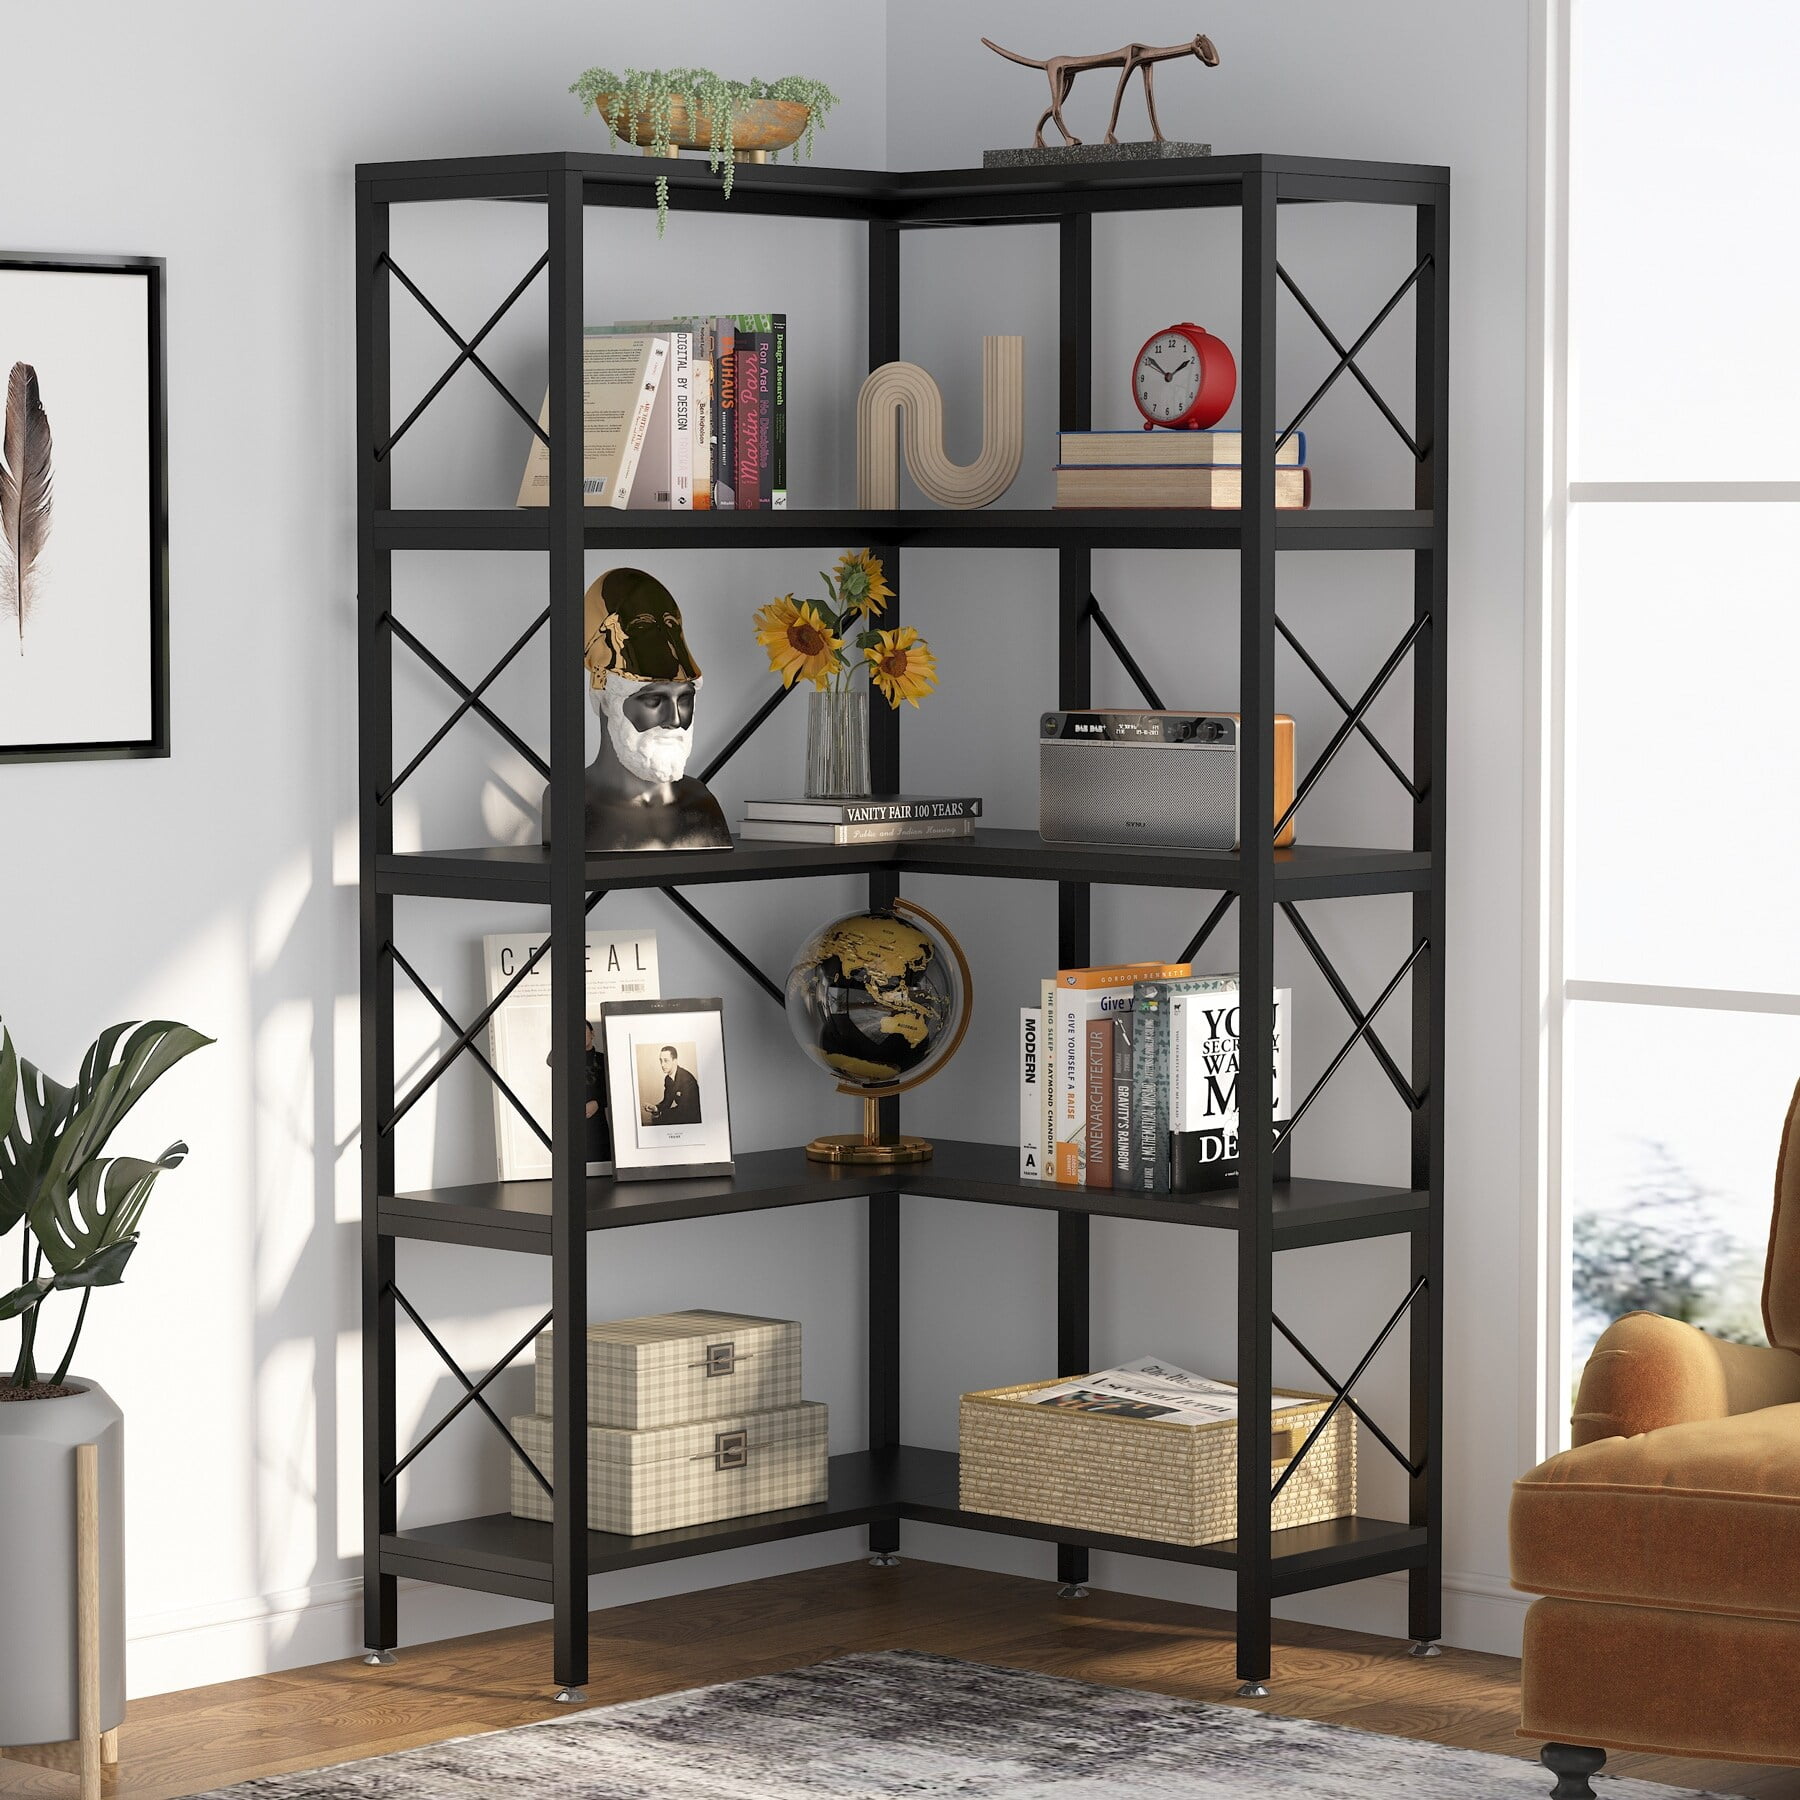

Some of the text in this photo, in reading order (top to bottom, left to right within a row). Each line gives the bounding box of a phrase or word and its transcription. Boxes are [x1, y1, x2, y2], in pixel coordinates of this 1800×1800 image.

[760, 342, 768, 364] Ron
[775, 334, 784, 364] Design
[1155, 345, 1162, 354] 11
[1168, 339, 1177, 349] 12
[1183, 344, 1187, 353] 1
[1190, 356, 1196, 365] 2
[677, 333, 687, 431] DIGITAL BY DESIGN
[721, 337, 735, 409] BAUHAUS
[760, 367, 768, 392] Arad
[1140, 374, 1145, 383] 9
[1194, 373, 1199, 382] 3
[776, 365, 784, 406] Research
[760, 399, 769, 416] No
[1152, 403, 1157, 412] 7
[1165, 407, 1170, 416] 6
[1178, 402, 1183, 411] 5
[740, 353, 758, 484] Martin Parr
[847, 802, 964, 822] VANITY FAIR 100 YEARS
[853, 828, 876, 839] Public
[879, 827, 895, 837] and
[501, 943, 647, 977] CEEAL
[1101, 970, 1184, 983] GORDON BENNETT
[1100, 996, 1125, 1011] Give
[1068, 1013, 1076, 1033] GIVE
[1025, 1018, 1036, 1084] MODERN
[1067, 1037, 1075, 1081] YOURSELF
[1089, 1031, 1103, 1163] INNENARCHITEKTUR
[1141, 1082, 1157, 1107] MOSAIC
[1067, 1093, 1075, 1120] RAISE
[1117, 1085, 1129, 1171] GRAVITY'S RAINBOW
[1141, 1109, 1156, 1156] MATHEMATICAL
[1026, 1153, 1036, 1168] A
